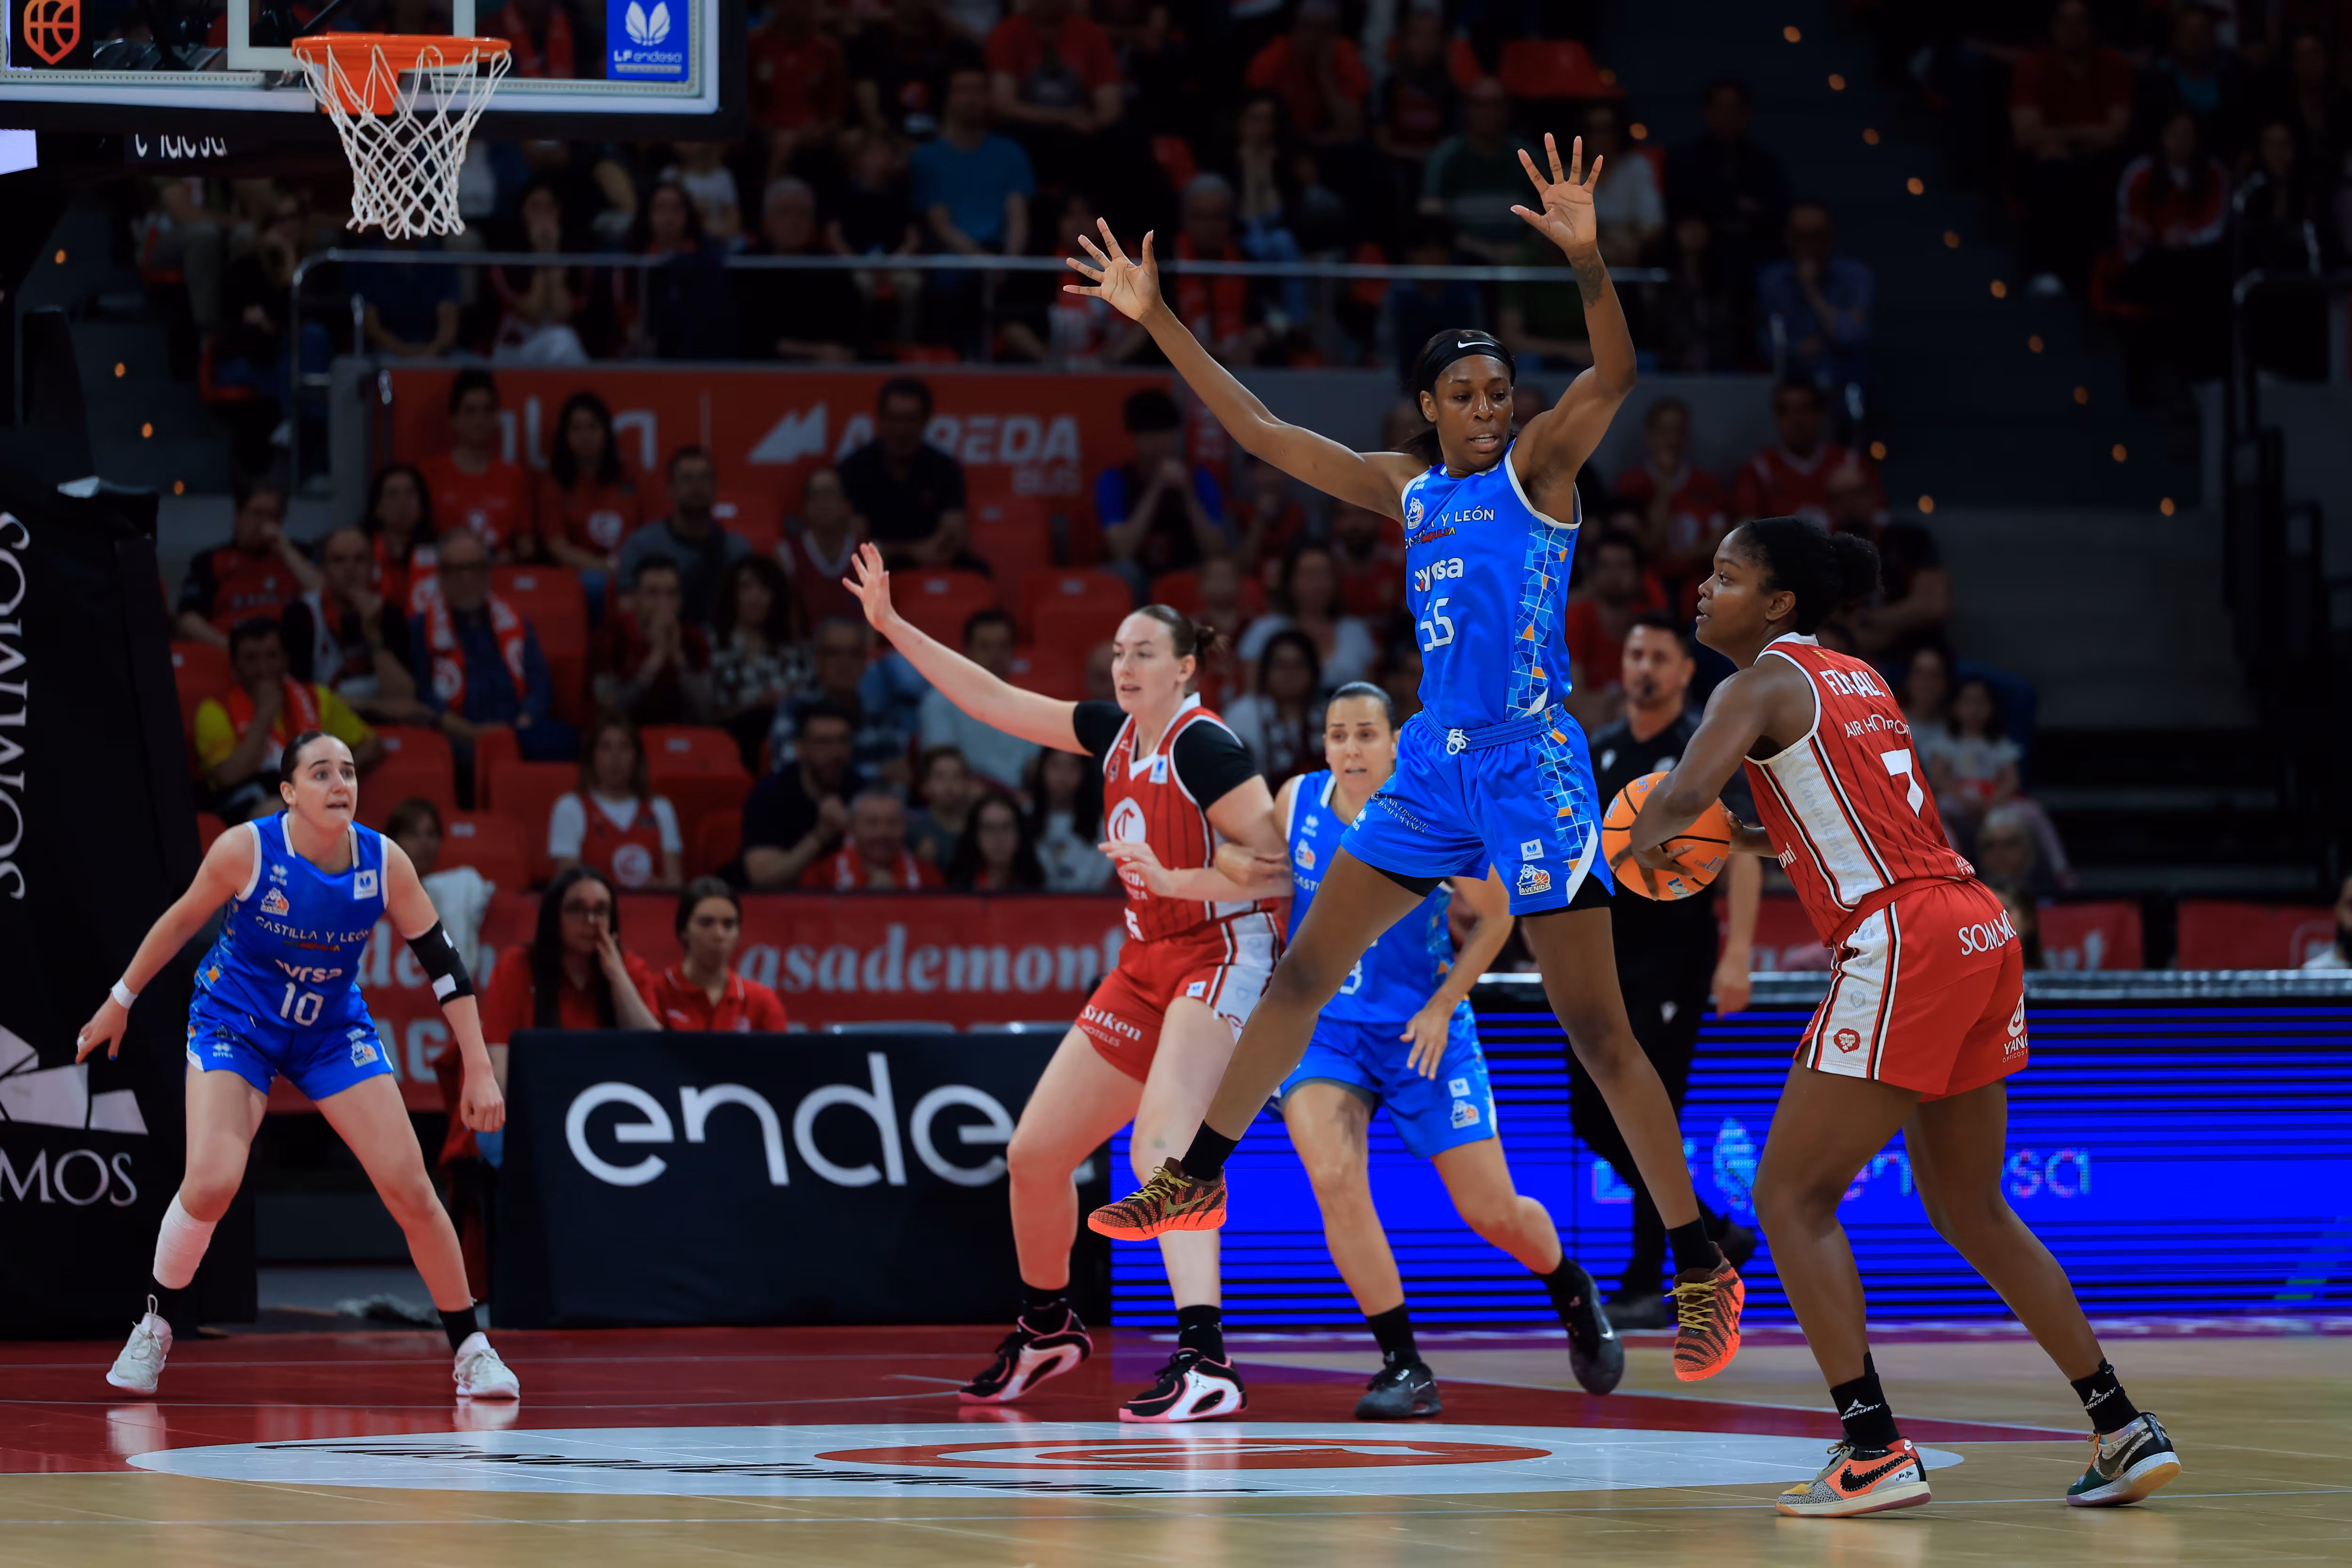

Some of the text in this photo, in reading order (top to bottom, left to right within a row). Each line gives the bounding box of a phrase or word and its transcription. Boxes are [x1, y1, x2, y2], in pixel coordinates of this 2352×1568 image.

[613, 49, 682, 63] LF endesa
[835, 415, 1081, 464] AREDA
[1454, 505, 1495, 523] LEÓN
[1420, 597, 1454, 652] 55
[1844, 720, 1865, 738] AIR
[1880, 748, 1924, 818] 7
[1521, 882, 1550, 894] AVENIDA
[255, 916, 318, 941] CASTILLA
[326, 931, 335, 943] Y
[739, 923, 1128, 992] asademont
[280, 982, 324, 1027] 10
[1080, 1004, 1142, 1042] Silken
[565, 1053, 1095, 1187] ende
